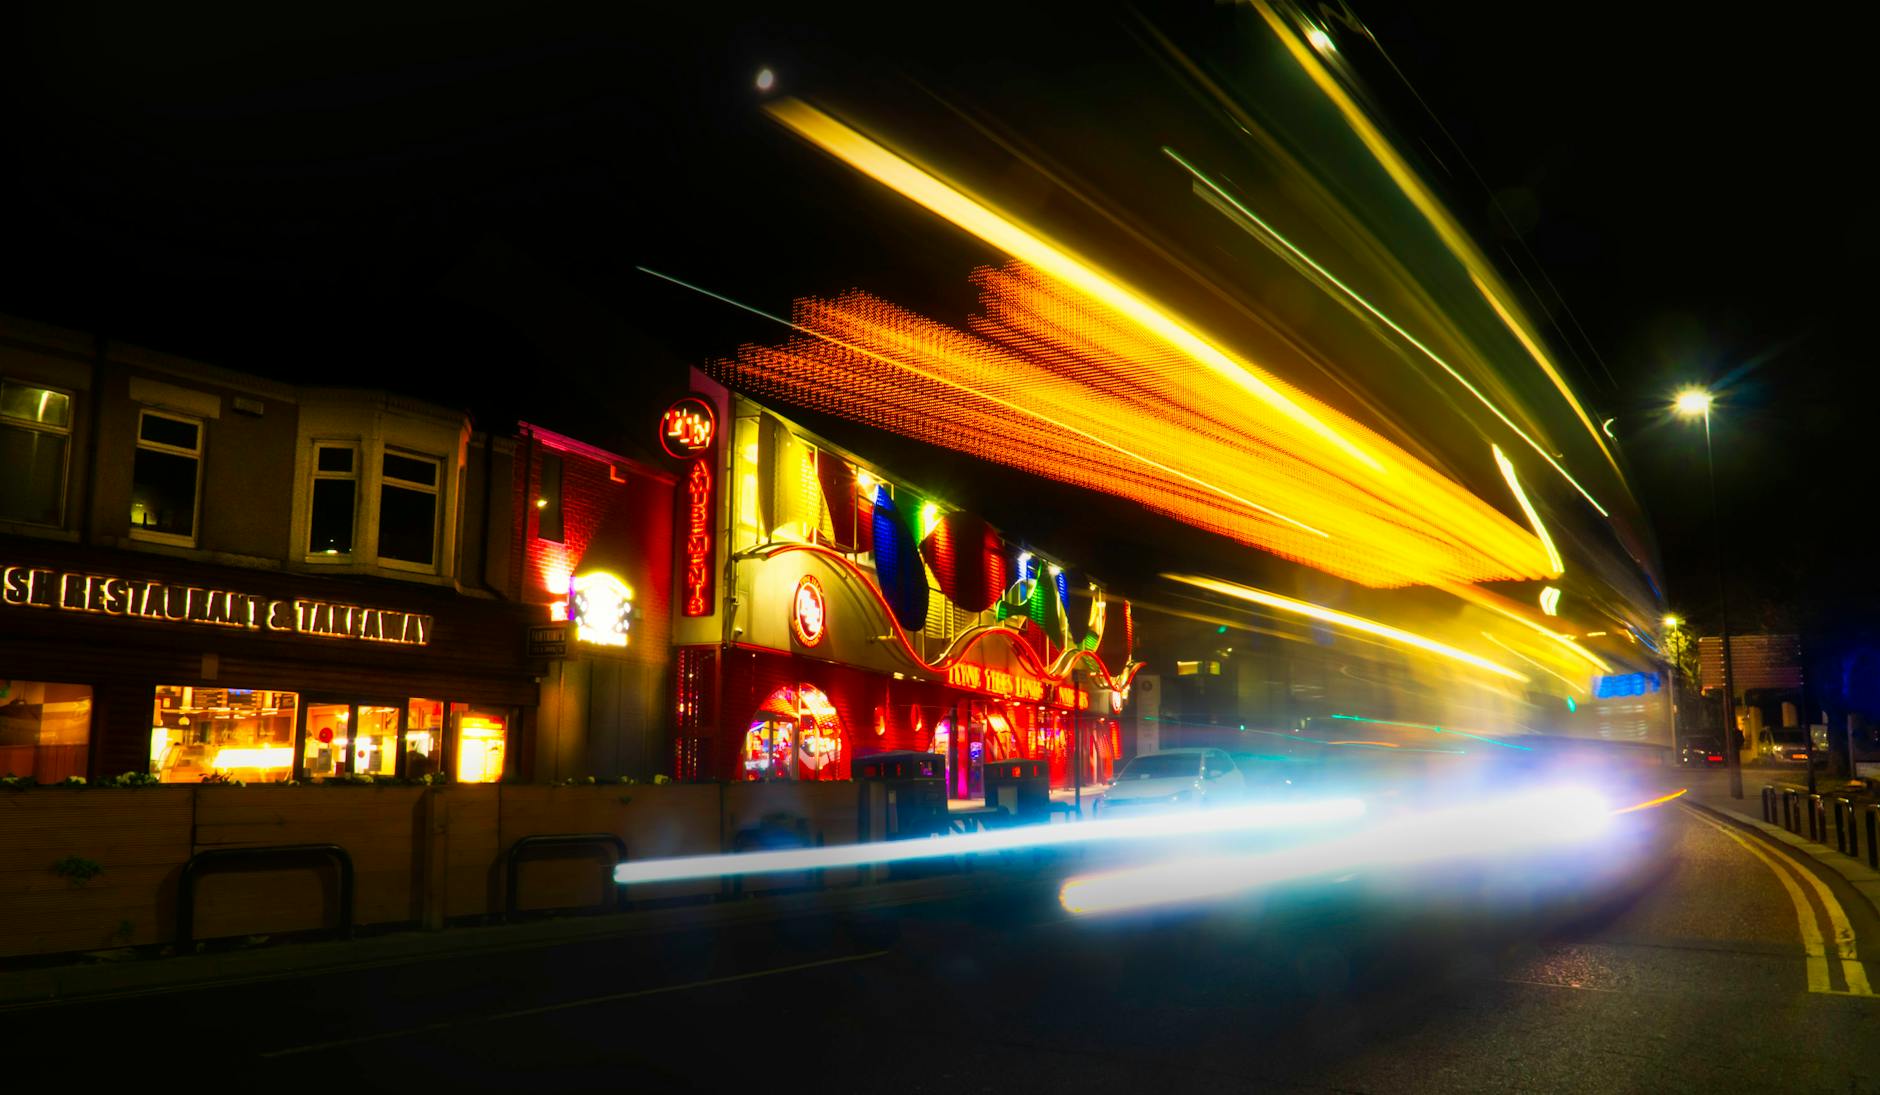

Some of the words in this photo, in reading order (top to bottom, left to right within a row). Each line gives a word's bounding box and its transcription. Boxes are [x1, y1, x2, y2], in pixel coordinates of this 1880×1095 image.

[687, 459, 712, 616] AMUSEMENTS
[0, 565, 55, 607] SH
[60, 572, 264, 629] RESTAURANT
[266, 600, 294, 632] &
[295, 597, 434, 646] TAKEAWAY
